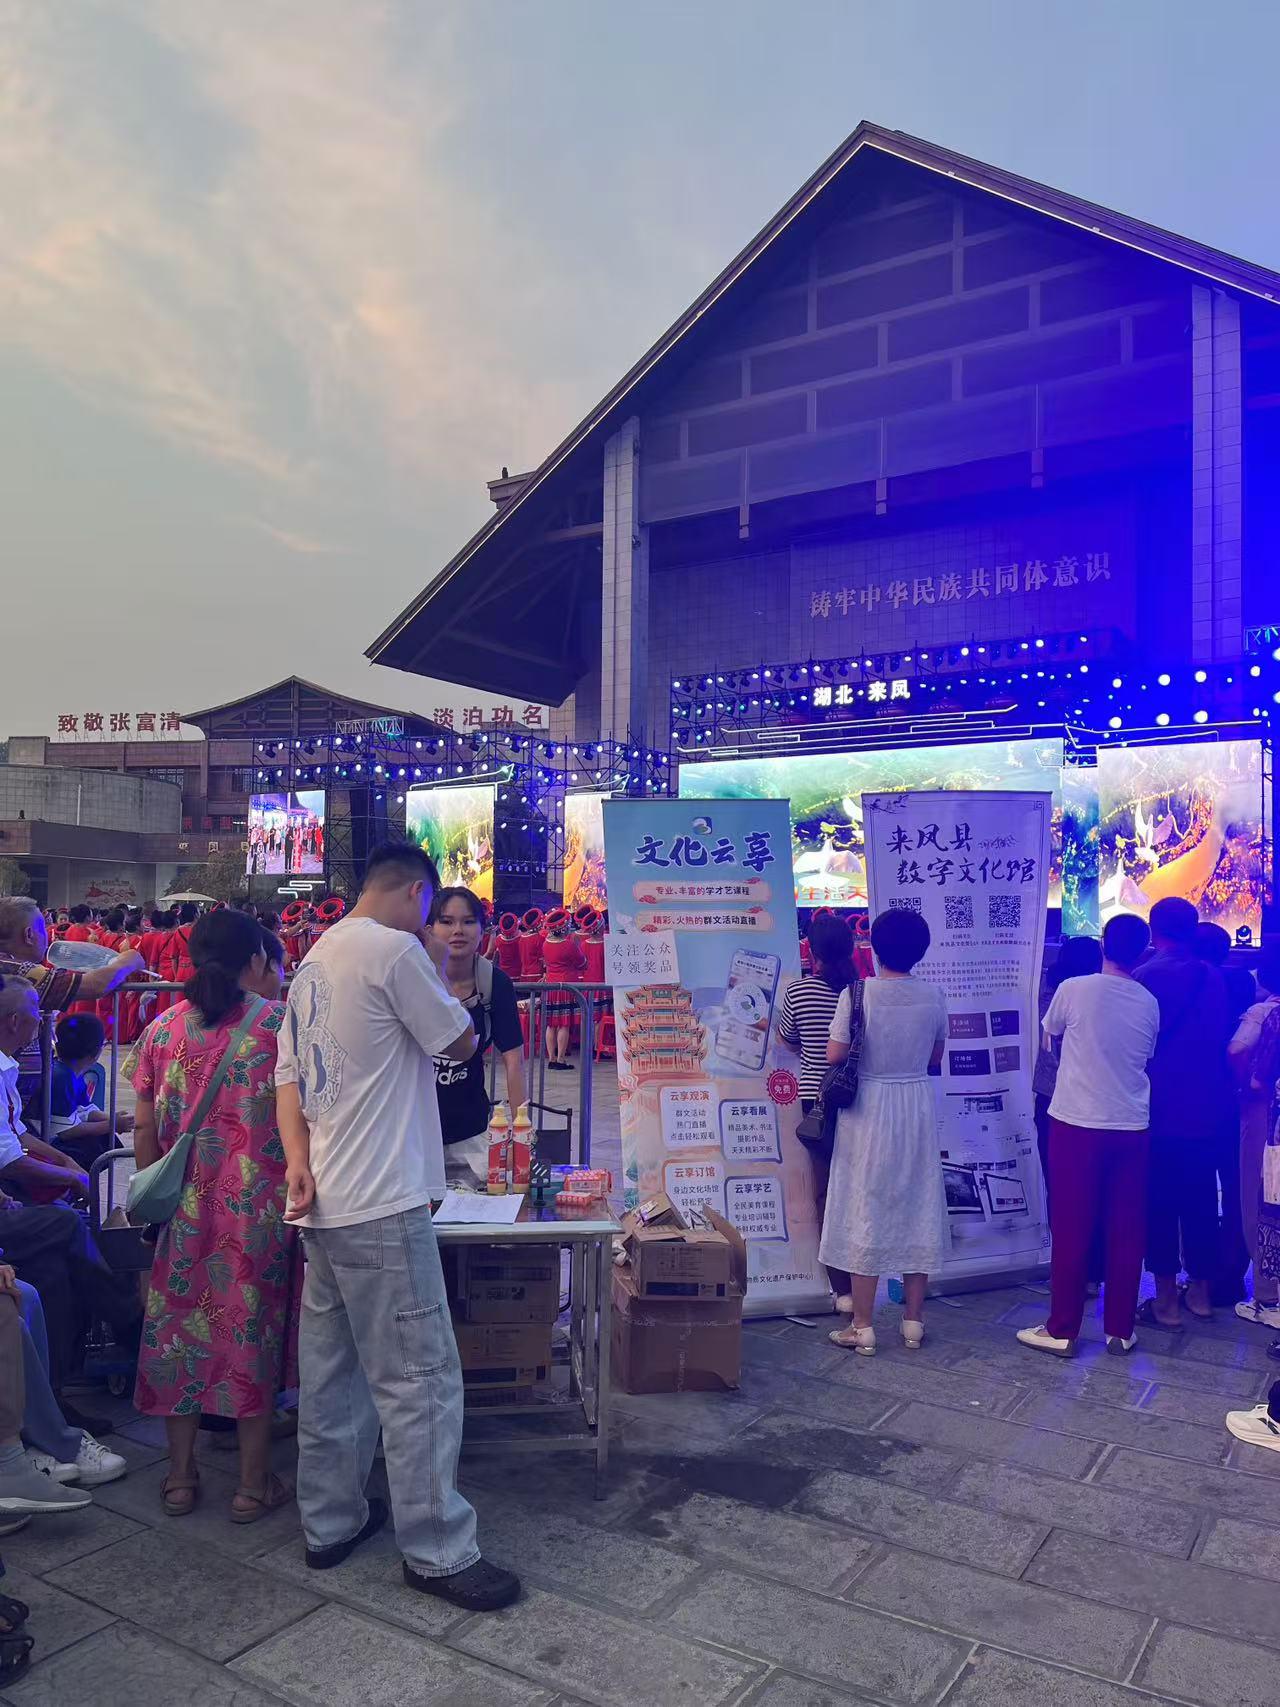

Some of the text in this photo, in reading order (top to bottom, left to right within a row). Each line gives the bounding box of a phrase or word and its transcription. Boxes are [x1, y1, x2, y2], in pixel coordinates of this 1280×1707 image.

[808, 551, 1112, 618] 铸牢中华民族共同体意识
[58, 711, 181, 733] 致敬张富清
[433, 704, 542, 728] 淡泊功名
[886, 822, 974, 854] 来凤县
[633, 831, 776, 873] 文化云享
[896, 857, 1036, 886] 数字文化馆
[655, 886, 750, 896] 专业、丰富的学才艺课程
[653, 915, 757, 925] 精彩、火热的群文活动直播
[611, 941, 671, 957] 关注公众
[612, 959, 672, 975] 号领奖品
[433, 1066, 468, 1085] idas
[670, 1090, 710, 1101] 云享观演
[731, 1105, 768, 1116] 云享看展
[674, 1166, 716, 1178] 云享订馆
[673, 1184, 719, 1194] 身边文化场馆
[735, 1183, 772, 1194] 云享学艺
